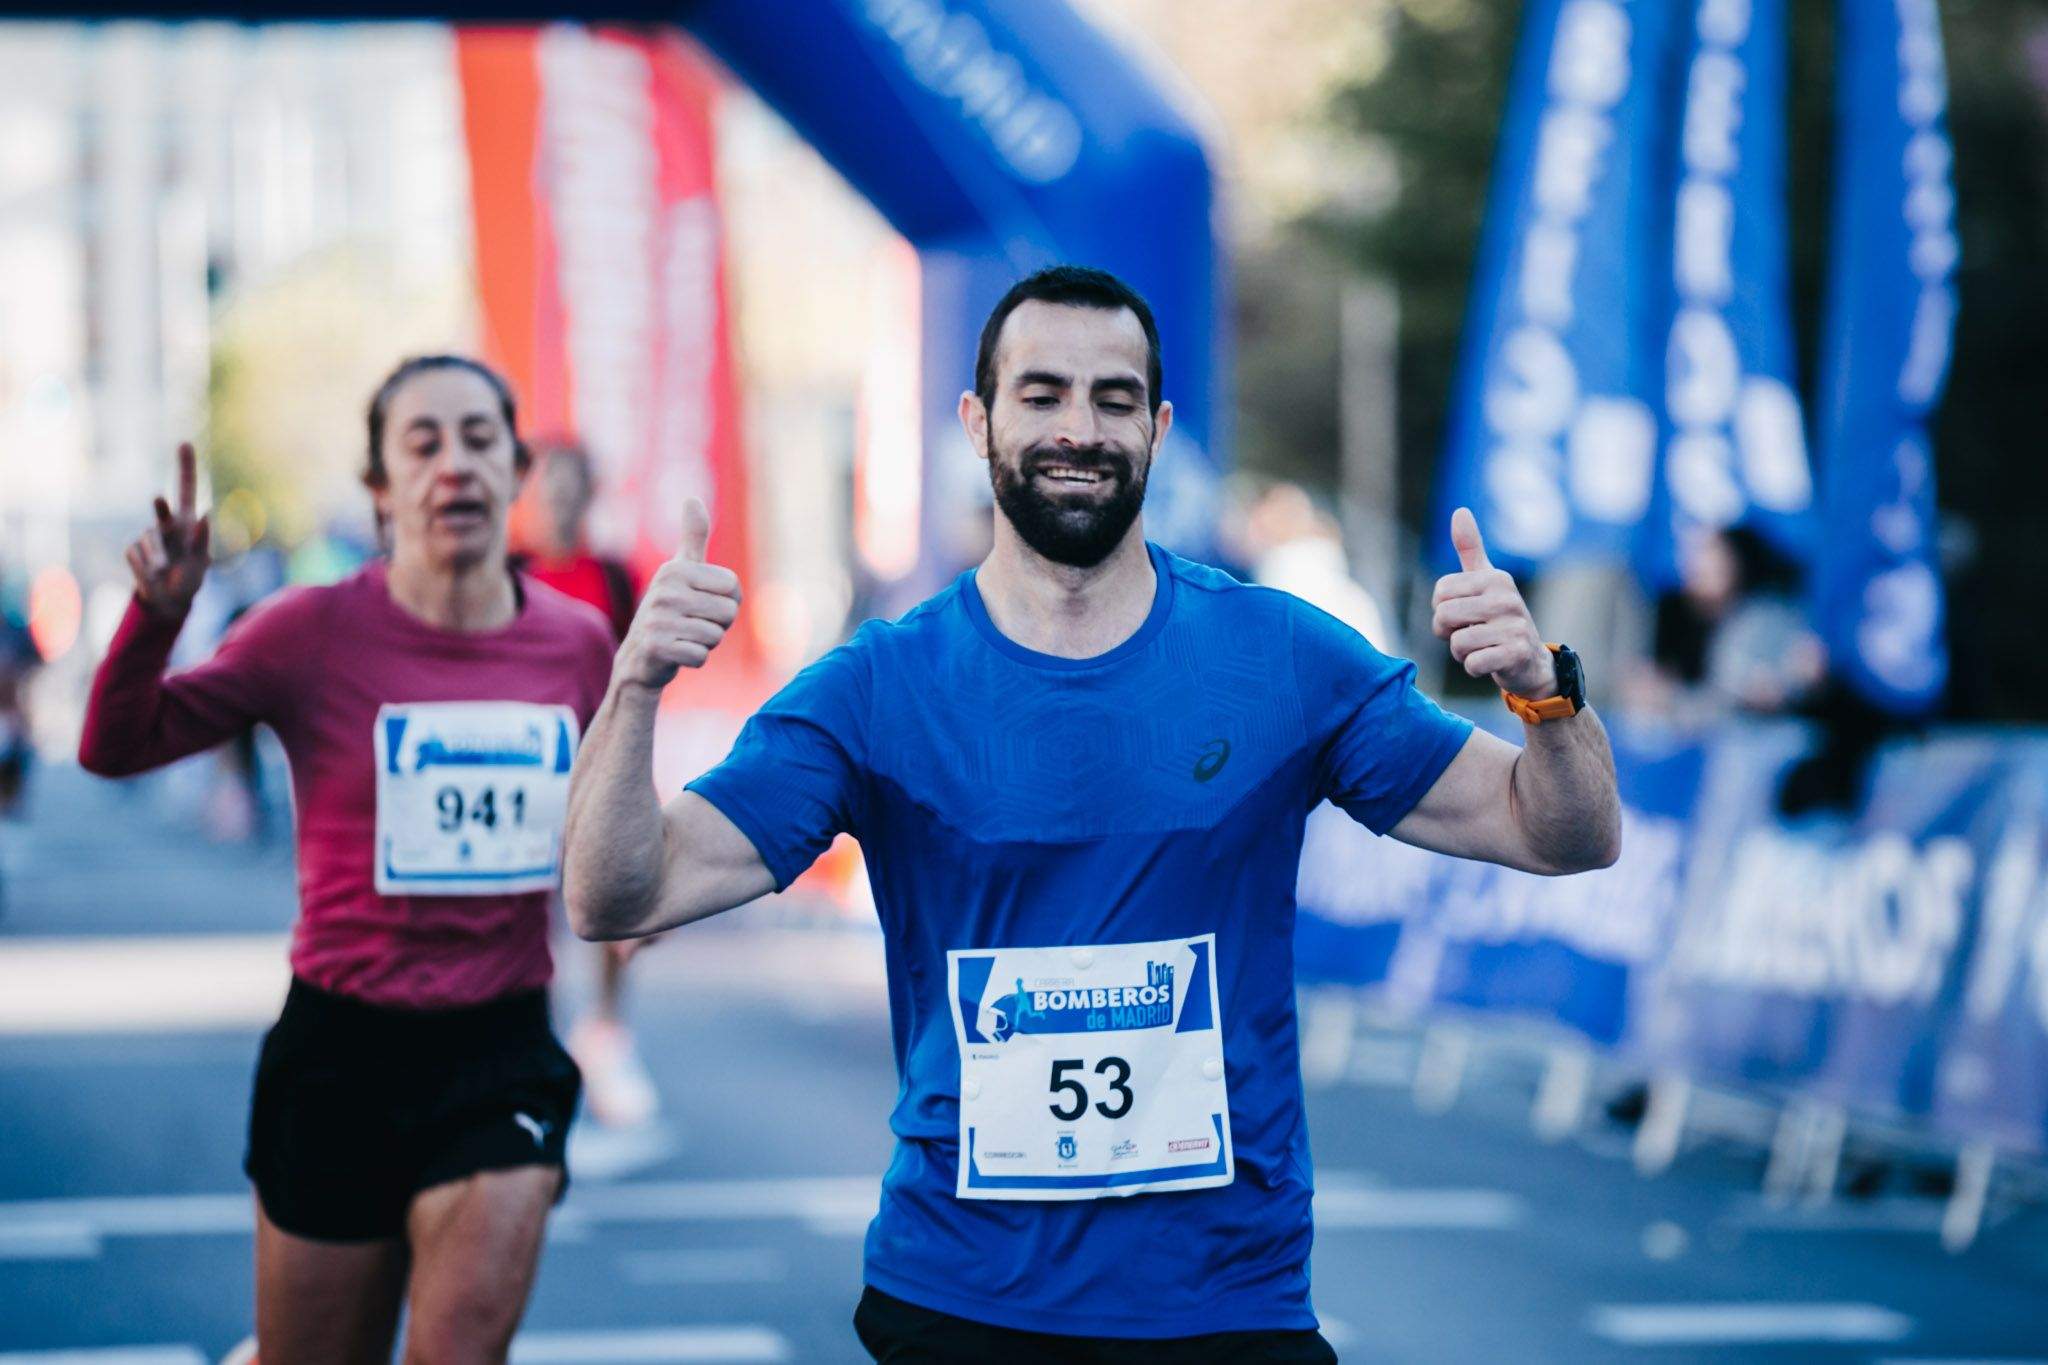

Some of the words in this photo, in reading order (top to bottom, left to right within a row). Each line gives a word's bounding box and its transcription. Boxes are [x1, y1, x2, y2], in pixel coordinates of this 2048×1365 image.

[436, 786, 526, 832] 941
[1033, 984, 1170, 1012] BOMBEROS
[1087, 1009, 1106, 1029] de
[1111, 1003, 1170, 1029] MADRID
[1049, 1056, 1135, 1121] 53
